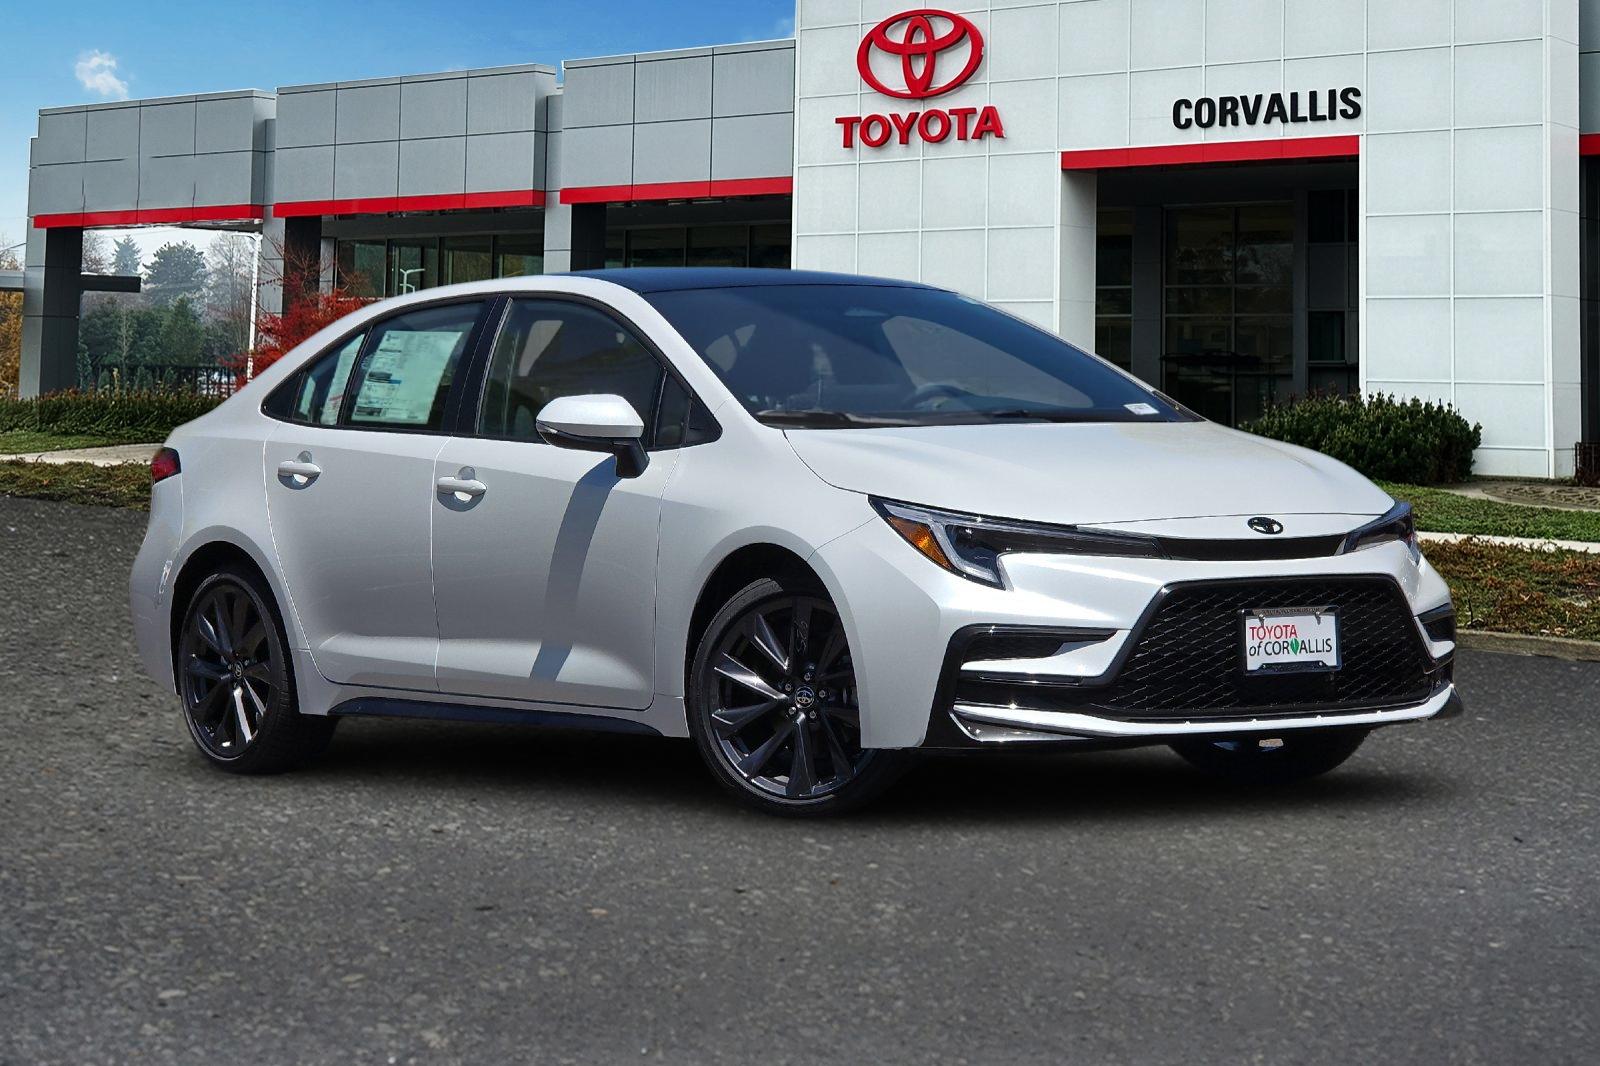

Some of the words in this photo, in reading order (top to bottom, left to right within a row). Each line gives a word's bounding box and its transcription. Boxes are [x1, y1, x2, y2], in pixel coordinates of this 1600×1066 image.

[1172, 87, 1362, 129] CORVALLIS
[835, 105, 1006, 148] TOYOTA
[1249, 624, 1298, 640] TOYOTA
[1249, 641, 1263, 656] of
